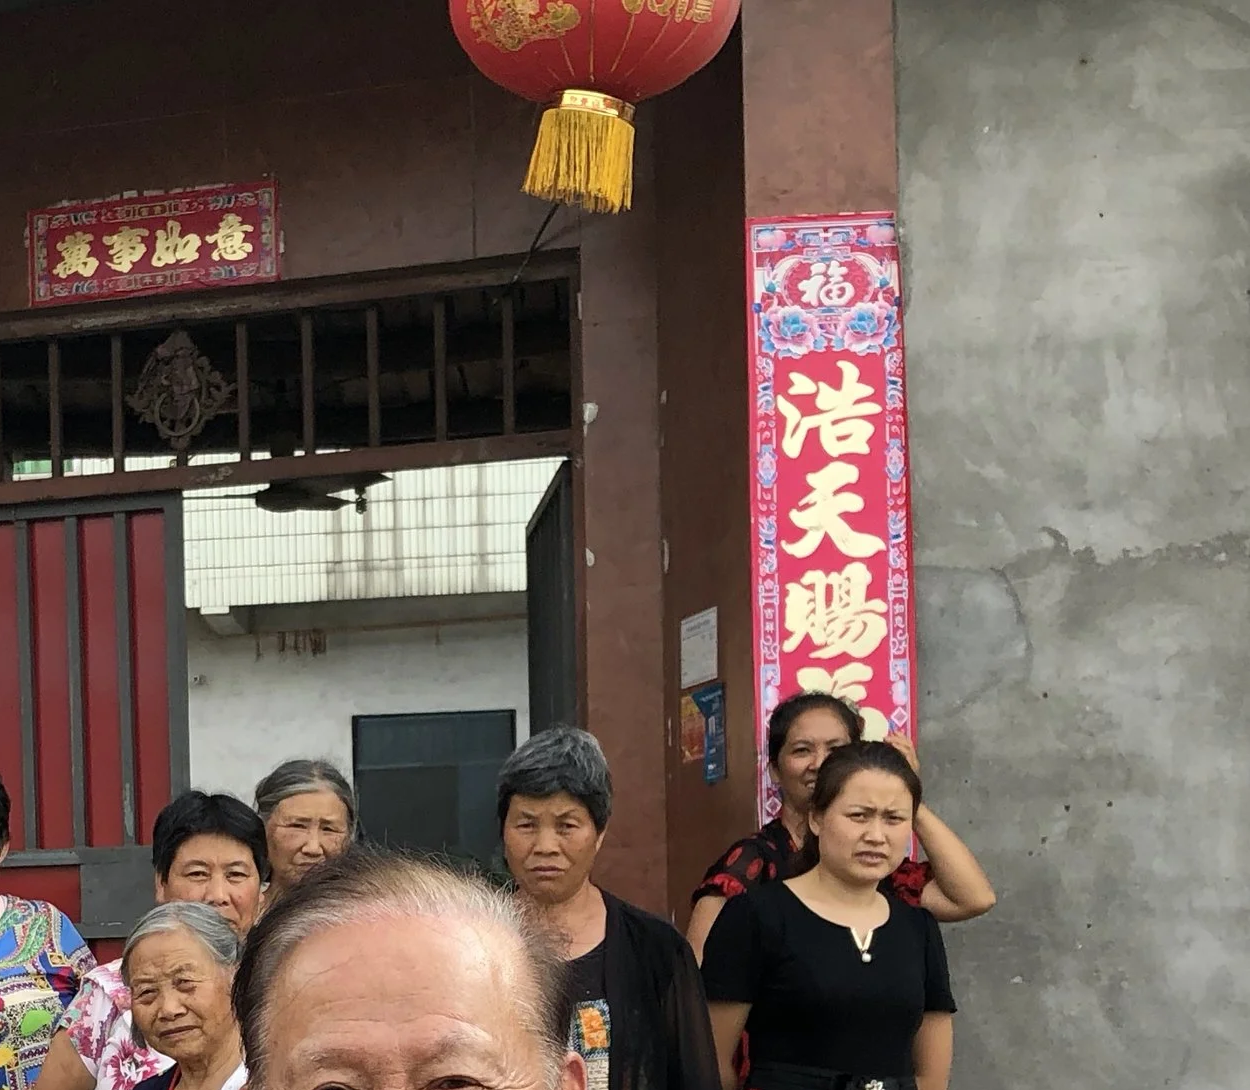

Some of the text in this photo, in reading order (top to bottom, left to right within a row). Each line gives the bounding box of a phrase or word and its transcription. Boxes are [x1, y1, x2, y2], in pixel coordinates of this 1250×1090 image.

[53, 213, 254, 279] 萬事如意
[797, 260, 855, 307] 福
